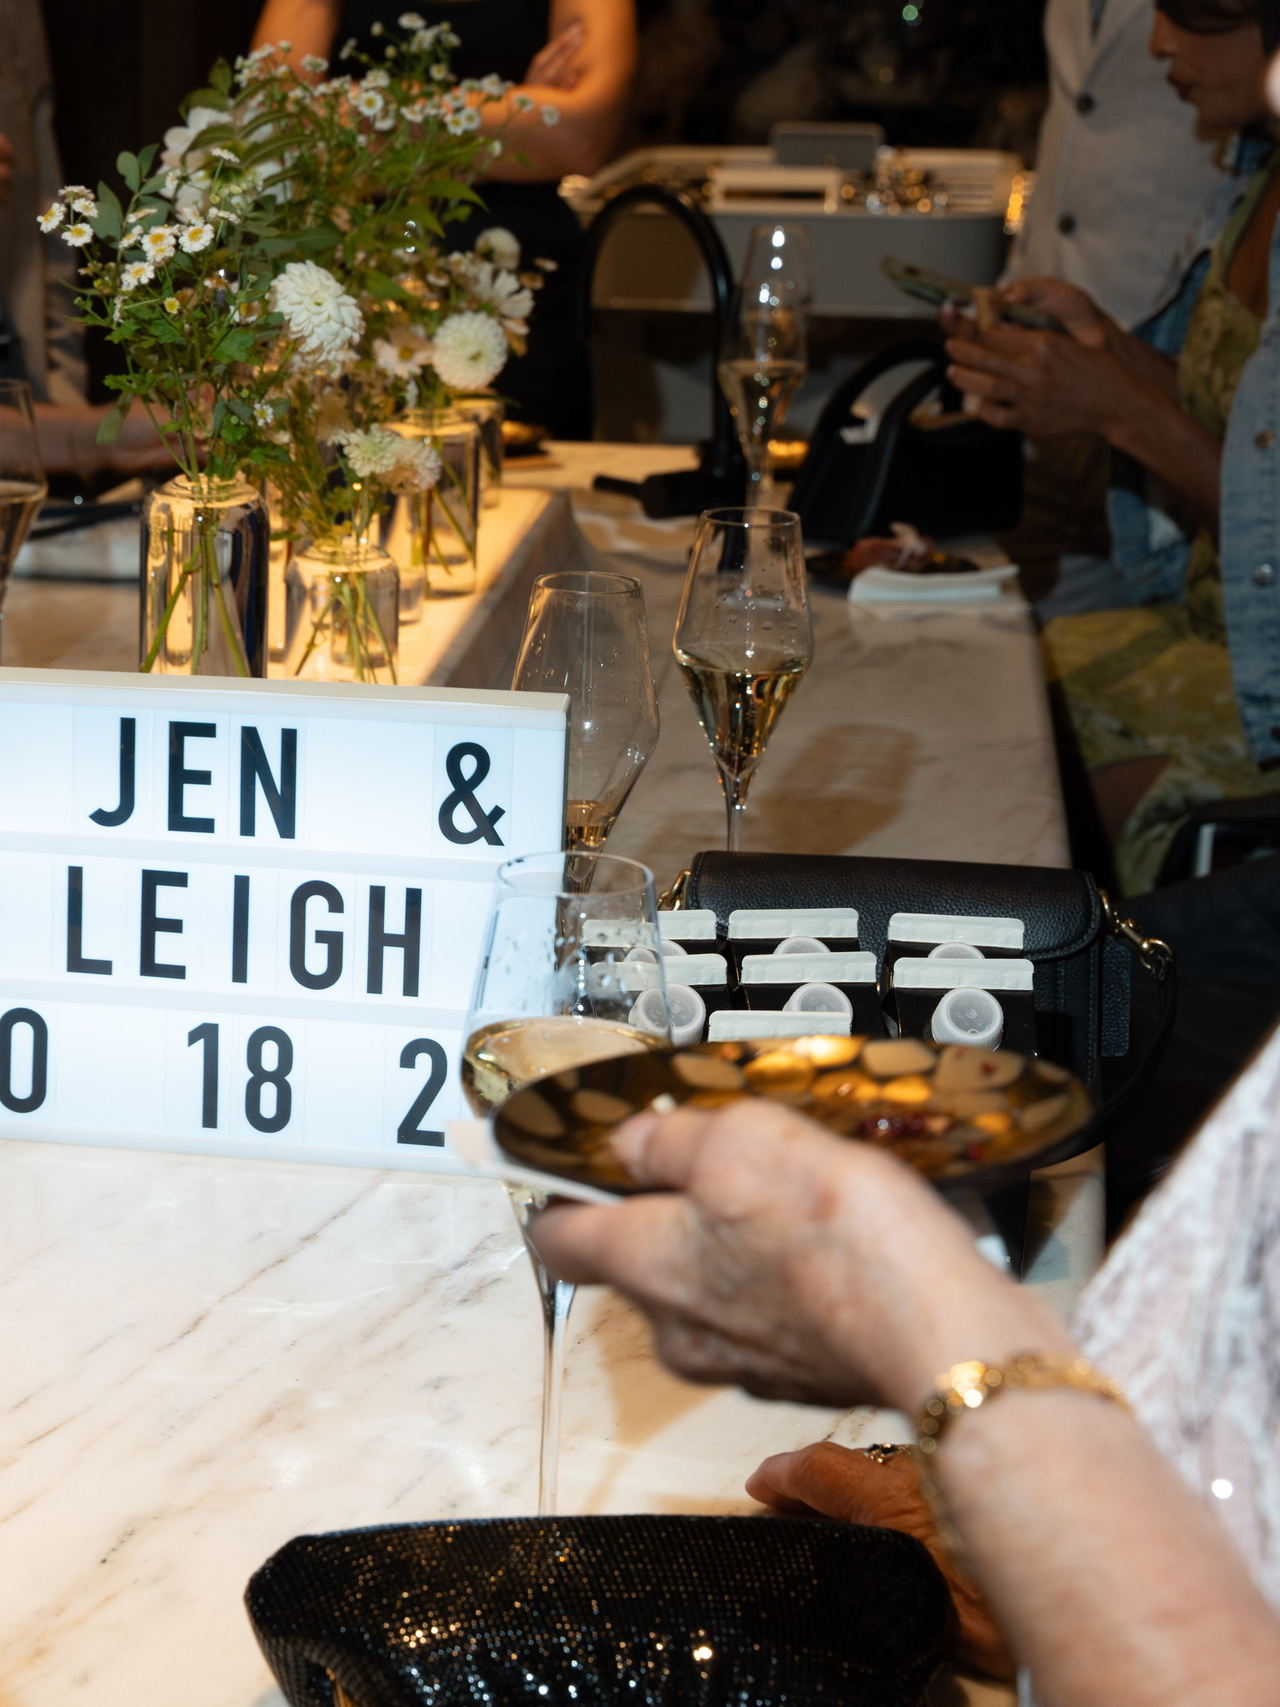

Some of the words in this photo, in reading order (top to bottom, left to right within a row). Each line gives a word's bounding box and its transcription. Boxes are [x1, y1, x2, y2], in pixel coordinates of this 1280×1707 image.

[89, 717, 297, 839] JEN
[439, 742, 505, 846] &
[67, 866, 422, 997] LEIGH
[188, 1023, 293, 1133] 18
